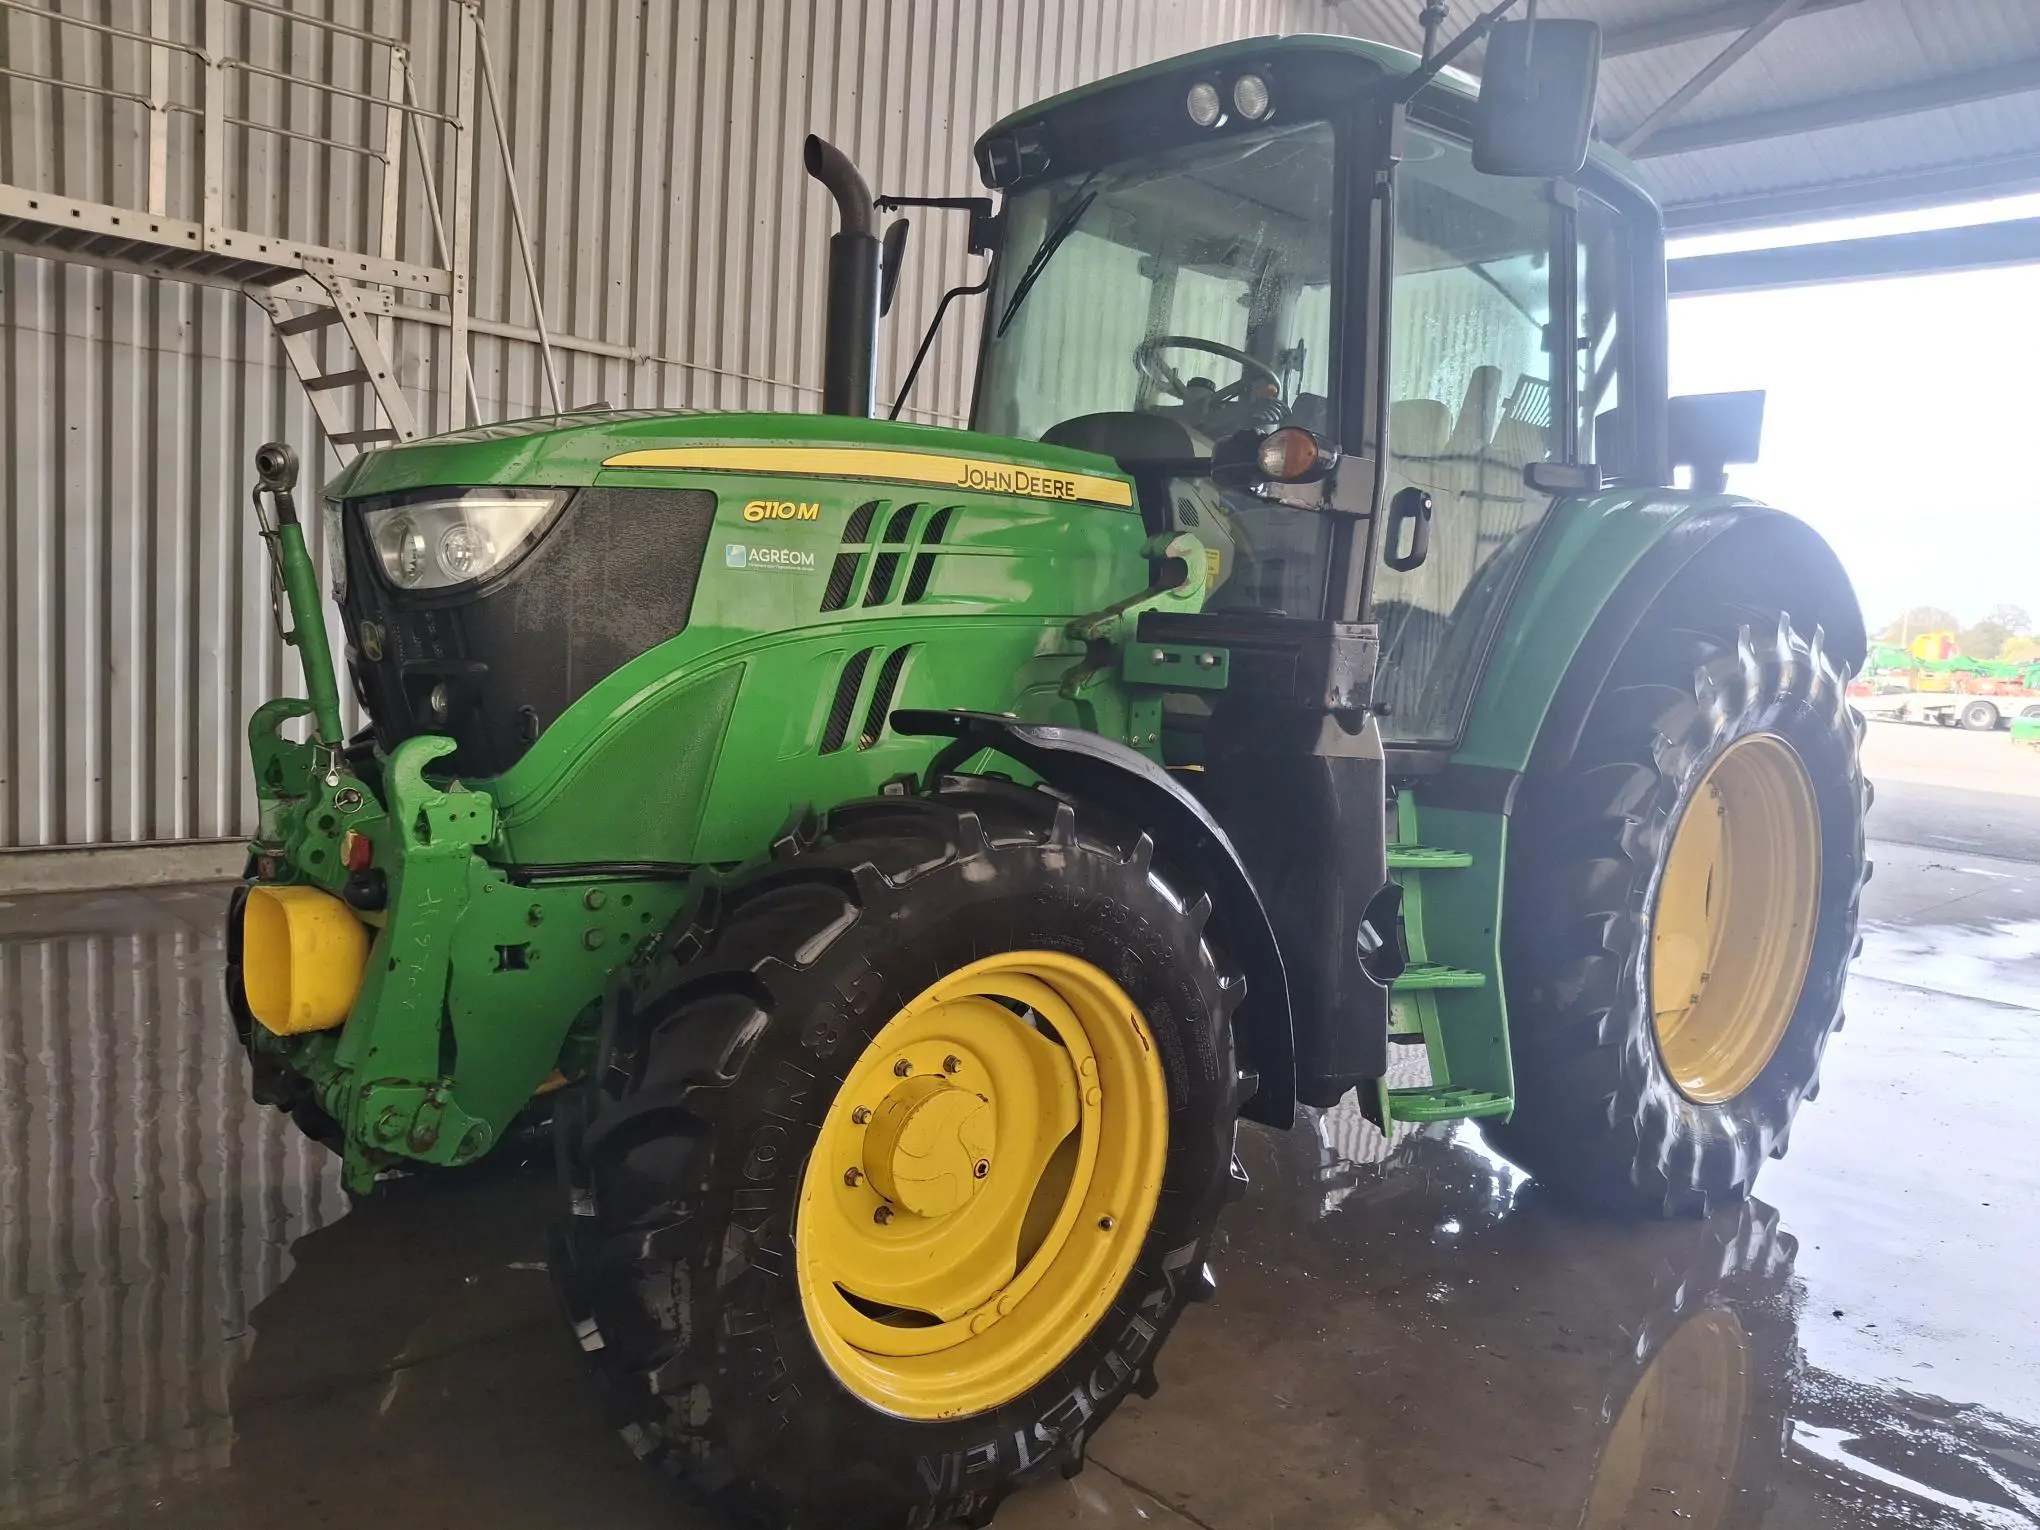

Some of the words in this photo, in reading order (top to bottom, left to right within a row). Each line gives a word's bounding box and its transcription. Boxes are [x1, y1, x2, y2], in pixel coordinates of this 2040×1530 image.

[958, 464, 1011, 490] JOHN
[1015, 470, 1075, 498] DEERE
[748, 547, 815, 566] AGRÉOM
[916, 1237, 1200, 1496] VREDESTEIN
